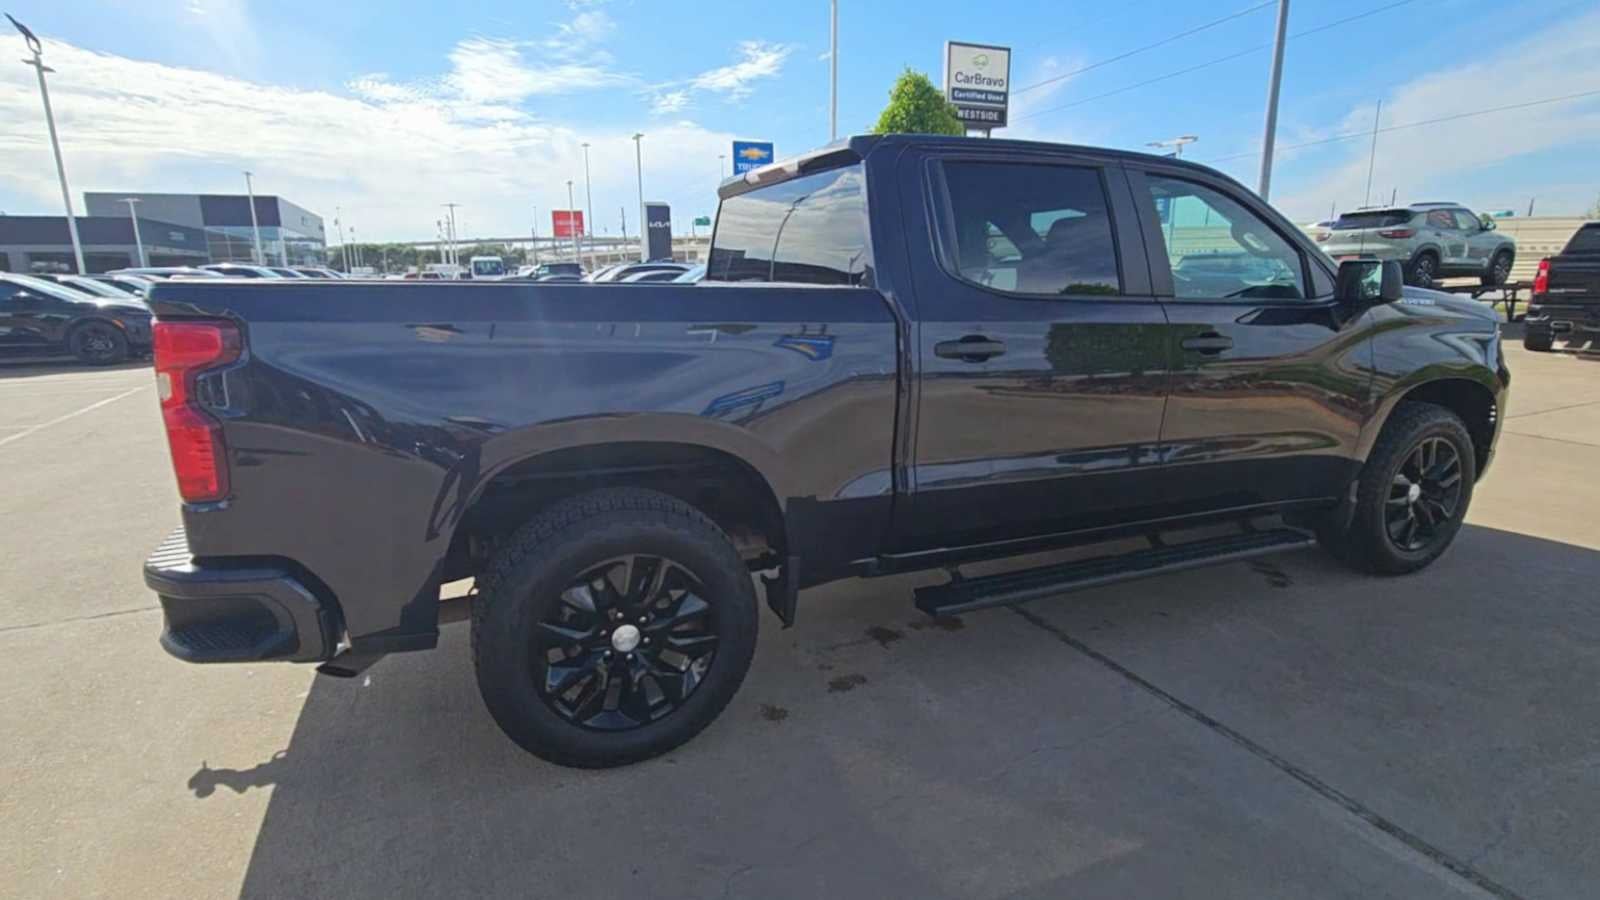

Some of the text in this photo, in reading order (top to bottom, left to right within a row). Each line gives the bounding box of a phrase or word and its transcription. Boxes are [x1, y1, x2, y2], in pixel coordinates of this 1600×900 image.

[955, 71, 1005, 87] CarBravo
[954, 89, 1004, 101] Certified Used
[957, 109, 1000, 121] WESTSIDE
